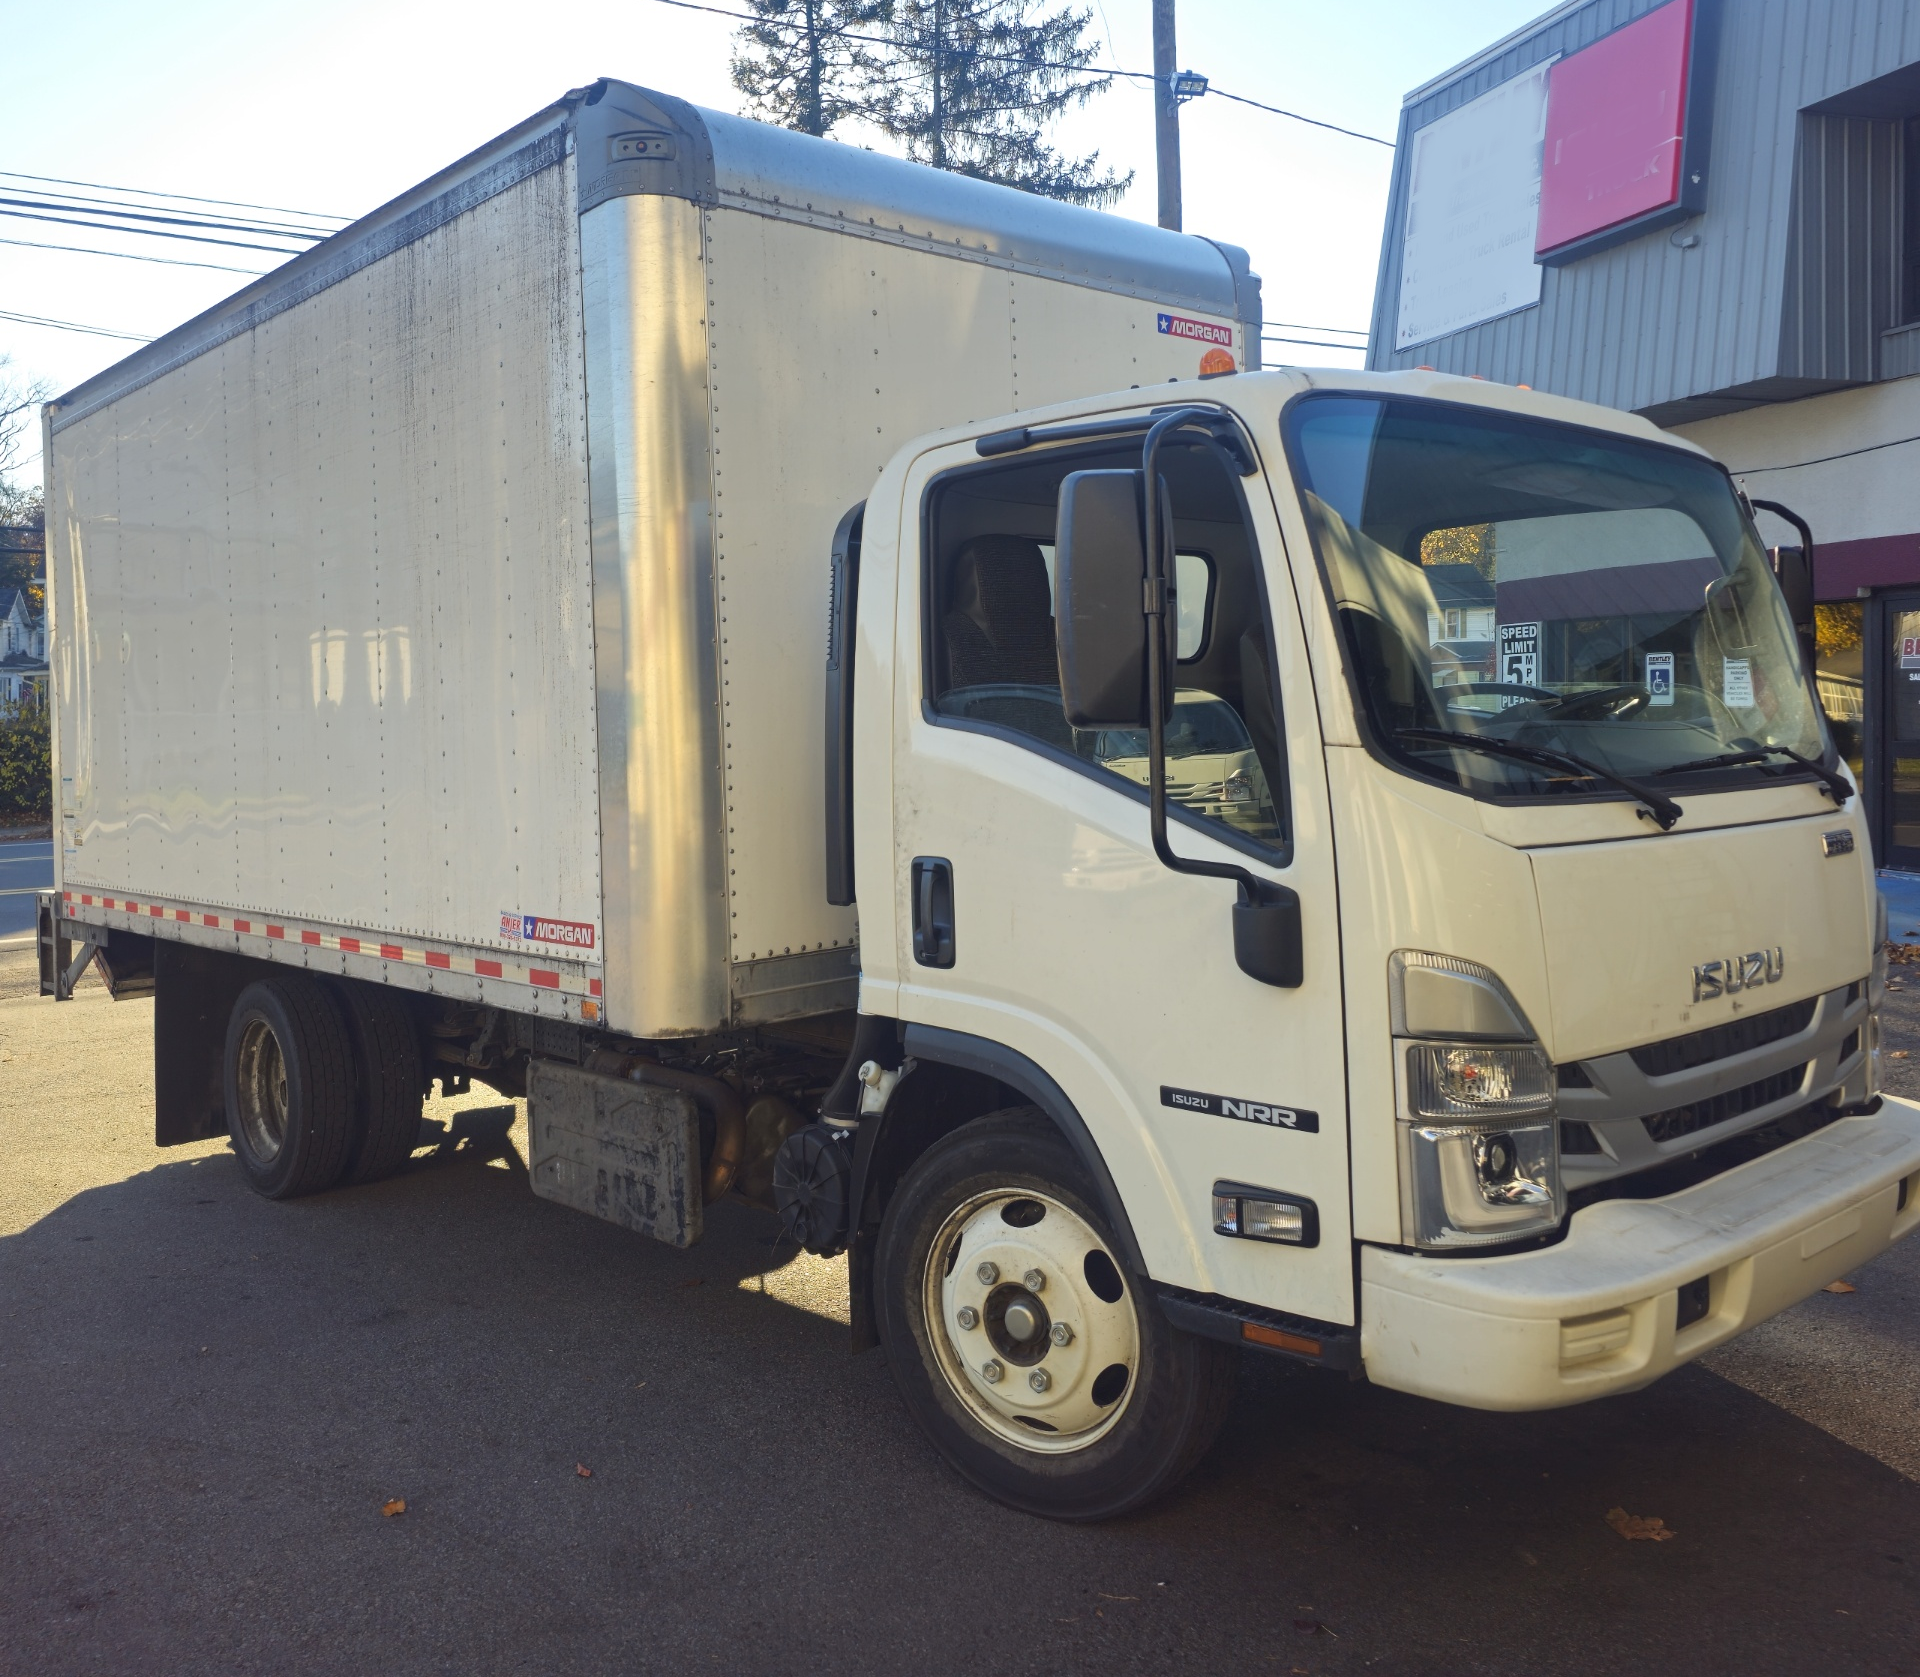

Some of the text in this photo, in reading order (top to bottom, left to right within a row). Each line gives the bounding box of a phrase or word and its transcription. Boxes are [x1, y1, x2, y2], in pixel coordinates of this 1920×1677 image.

[1468, 238, 1495, 262] Truck
[1497, 221, 1531, 250] Rental
[1407, 315, 1441, 338] Service
[1480, 291, 1507, 312] Sales
[1171, 320, 1229, 344] MORGAN
[1501, 625, 1537, 640] SPEED
[1504, 640, 1535, 653] LIMIT
[1507, 656, 1523, 684] 5
[1502, 695, 1537, 709] PLEA
[535, 921, 591, 945] MORGAN
[1690, 946, 1784, 1004] ISUZU
[1172, 1093, 1297, 1128] ISUZU NRR
